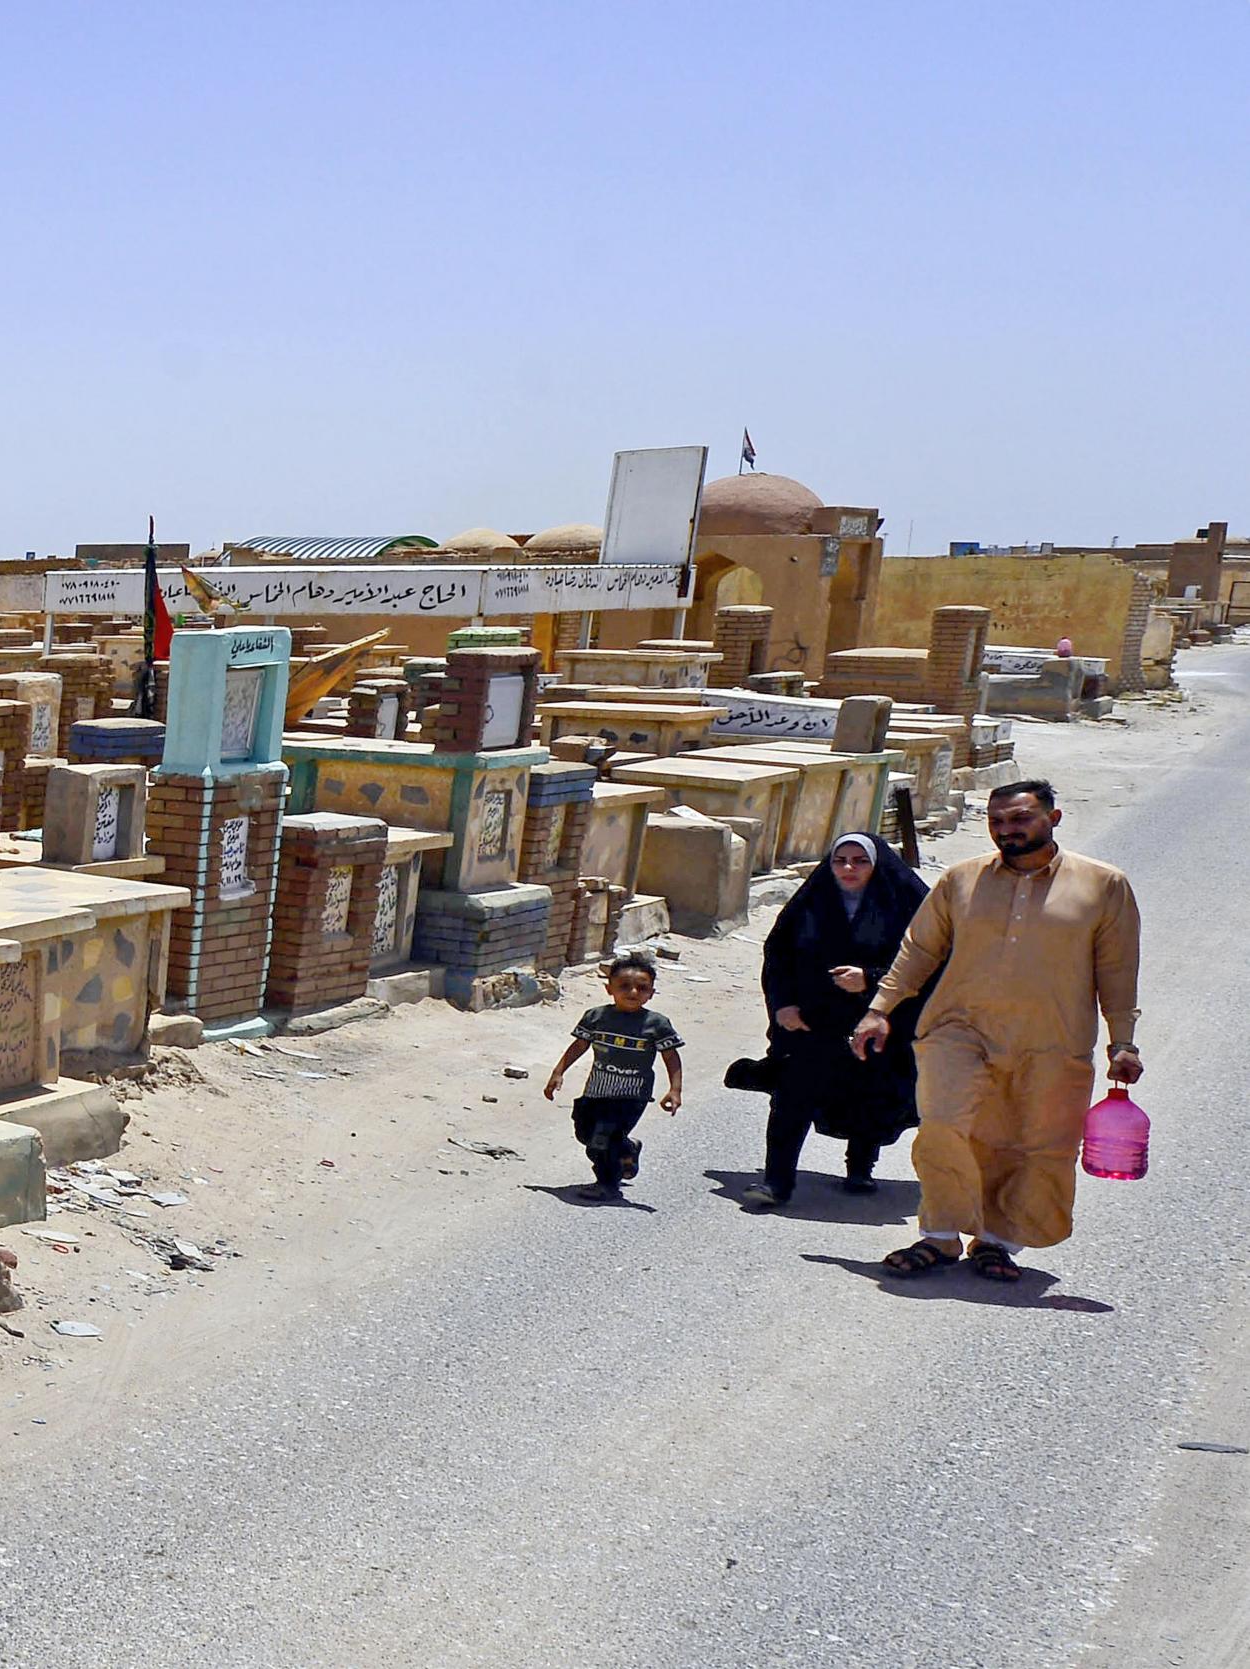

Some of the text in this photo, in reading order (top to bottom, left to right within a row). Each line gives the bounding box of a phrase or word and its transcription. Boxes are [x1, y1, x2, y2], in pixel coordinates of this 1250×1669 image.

[292, 580, 335, 608] دهام
[379, 586, 416, 609] عبد
[419, 583, 466, 610] الحاج
[716, 709, 748, 725] حق
[740, 707, 770, 728] الله
[606, 1064, 640, 1076] Over
